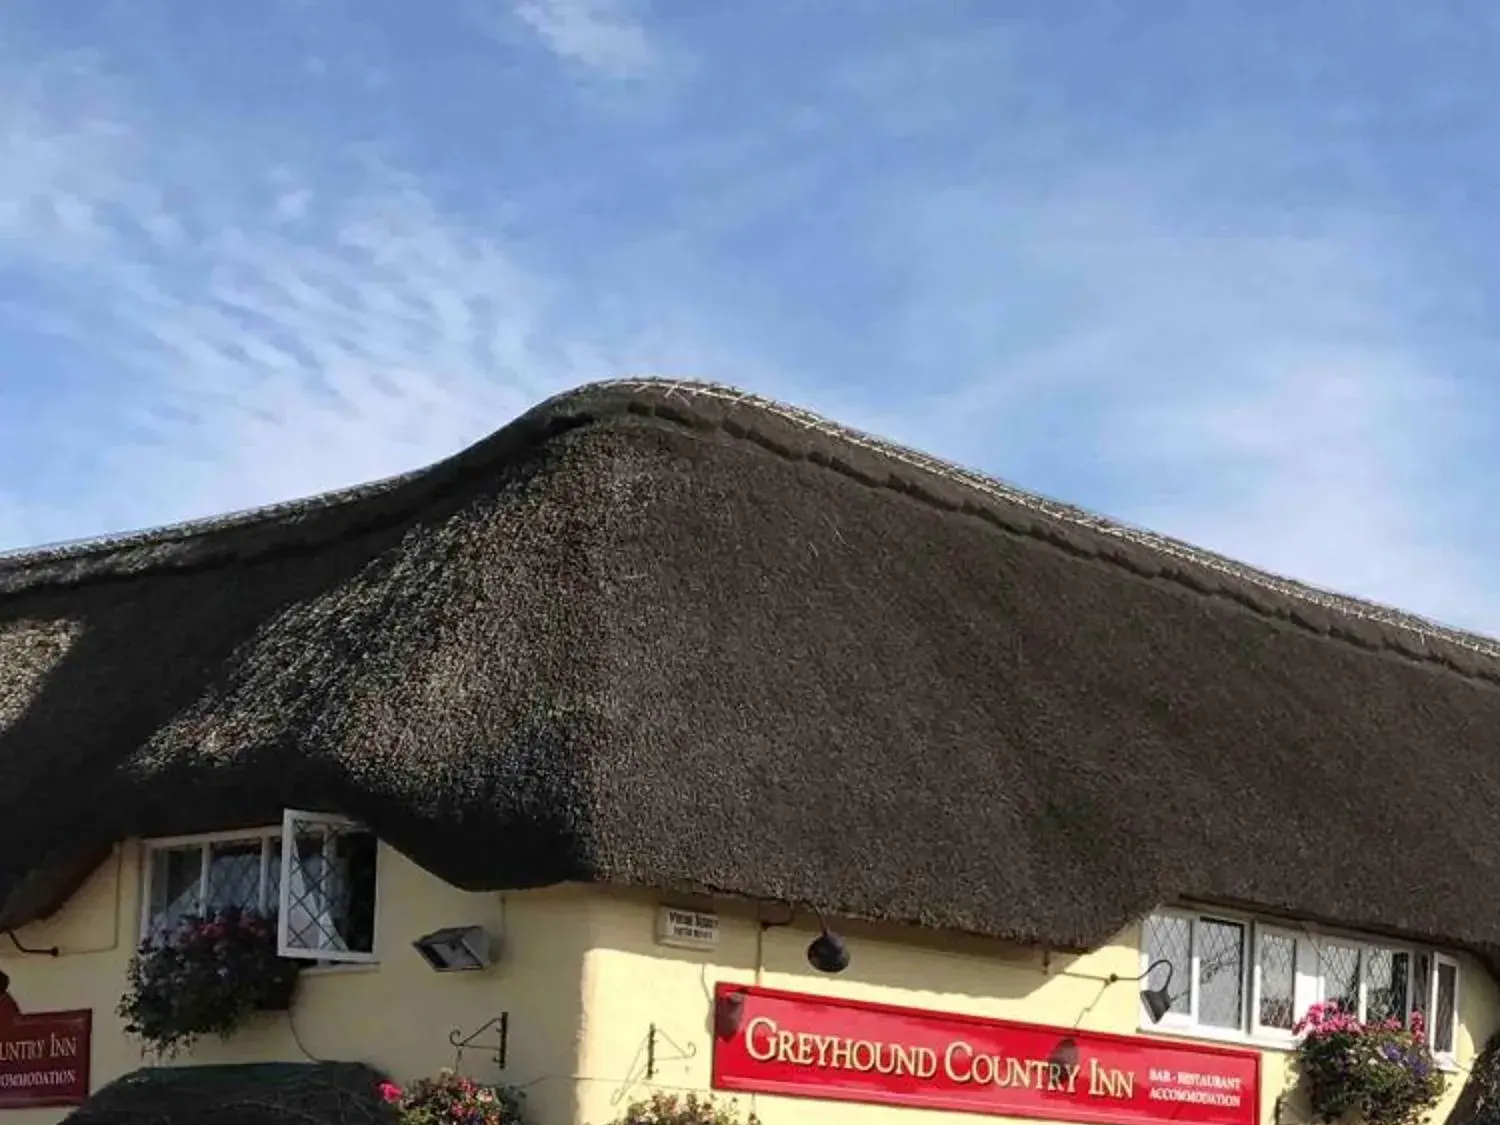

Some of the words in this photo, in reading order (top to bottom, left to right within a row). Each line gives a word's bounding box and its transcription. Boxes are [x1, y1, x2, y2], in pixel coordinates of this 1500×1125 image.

[49, 1032, 77, 1058] INN
[745, 1017, 937, 1078] GREYHOUND
[944, 1041, 1080, 1093] COUNTRY
[1088, 1058, 1135, 1098] INN
[1149, 1068, 1171, 1083] BAR
